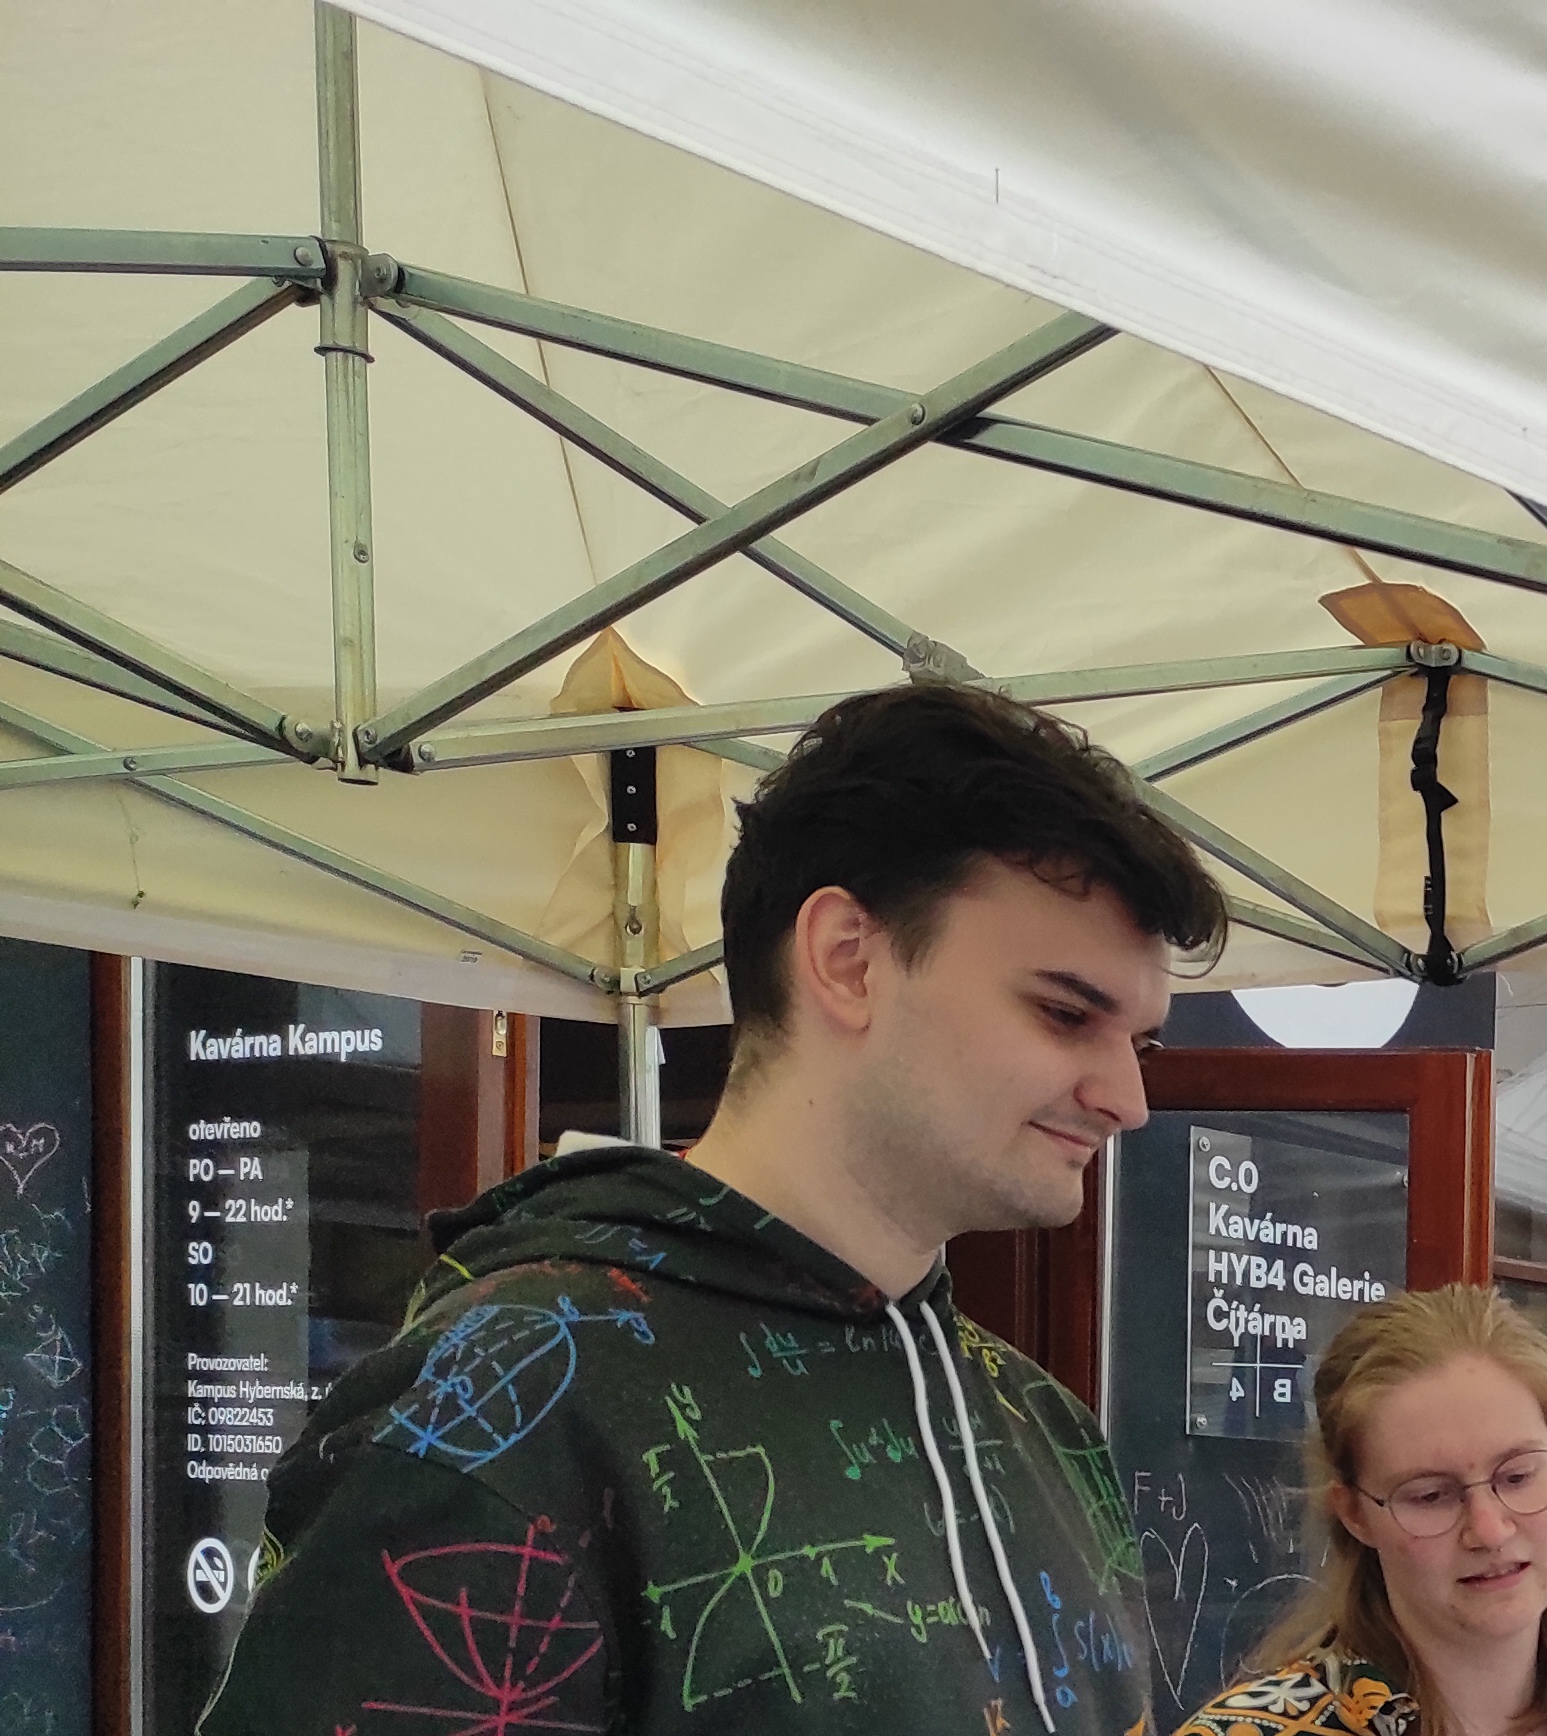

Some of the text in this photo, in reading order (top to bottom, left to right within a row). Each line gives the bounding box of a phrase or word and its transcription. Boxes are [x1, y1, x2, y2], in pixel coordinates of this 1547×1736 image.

[189, 1024, 383, 1062] Kavárna Kampus
[189, 1117, 261, 1140] otevřeno
[189, 1158, 214, 1181] PO
[189, 1201, 199, 1223] 9
[225, 1200, 246, 1222] 22
[1208, 1201, 1318, 1250] Kavárna
[188, 1241, 212, 1265] SO
[1207, 1249, 1386, 1303] HYB4 Galerie
[188, 1283, 208, 1306] 10
[232, 1283, 250, 1306] 21
[187, 1353, 268, 1371] Provozovatel:
[187, 1380, 236, 1402] Kampus
[208, 1407, 274, 1426] 09822453
[187, 1460, 258, 1483] Odpovědná
